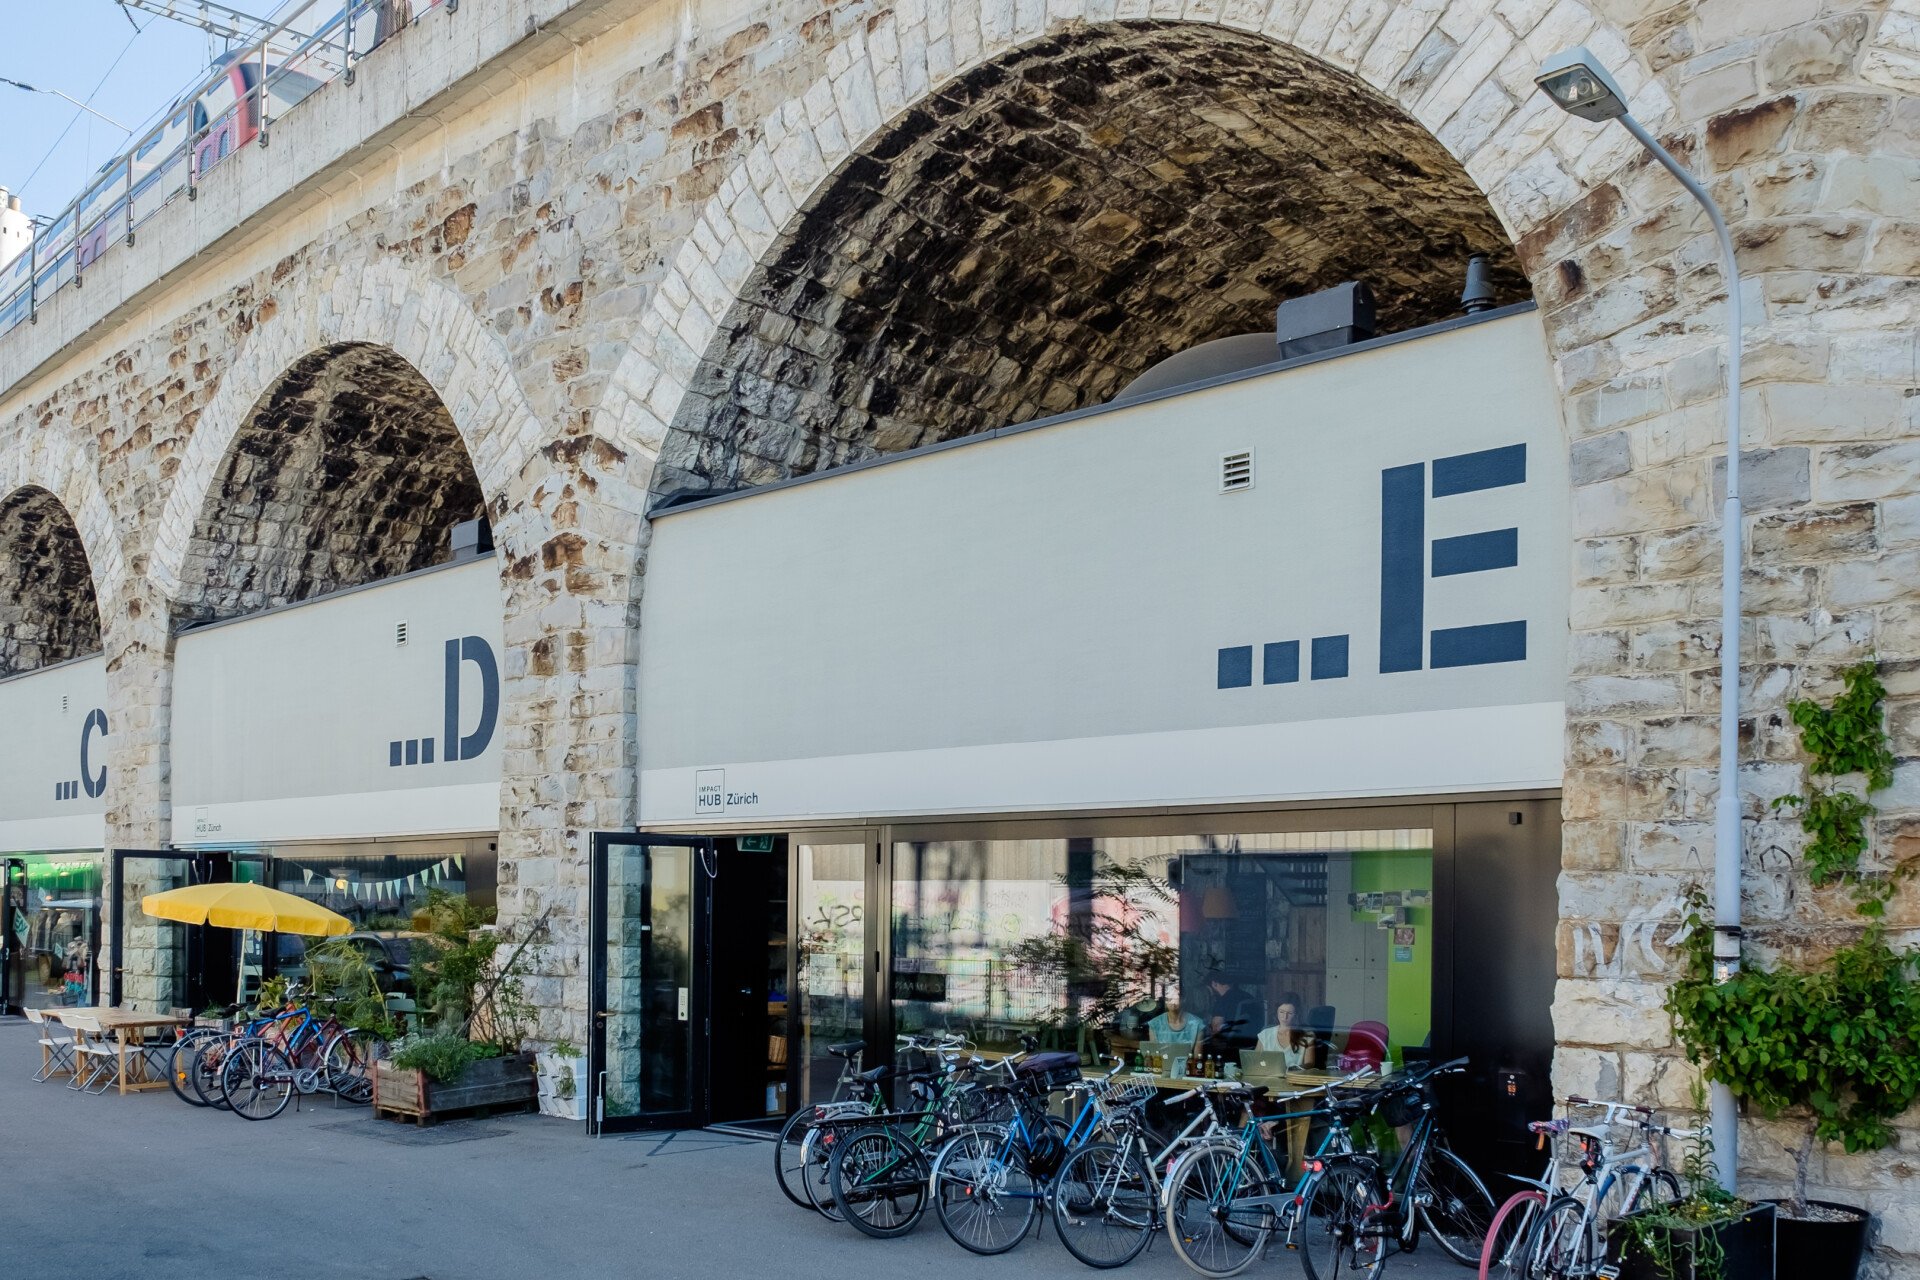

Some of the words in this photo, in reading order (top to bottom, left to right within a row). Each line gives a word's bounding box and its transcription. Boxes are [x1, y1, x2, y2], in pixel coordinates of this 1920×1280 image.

[698, 785, 721, 793] IMPACT
[698, 793, 722, 807] HUB
[726, 792, 759, 806] Zürich
